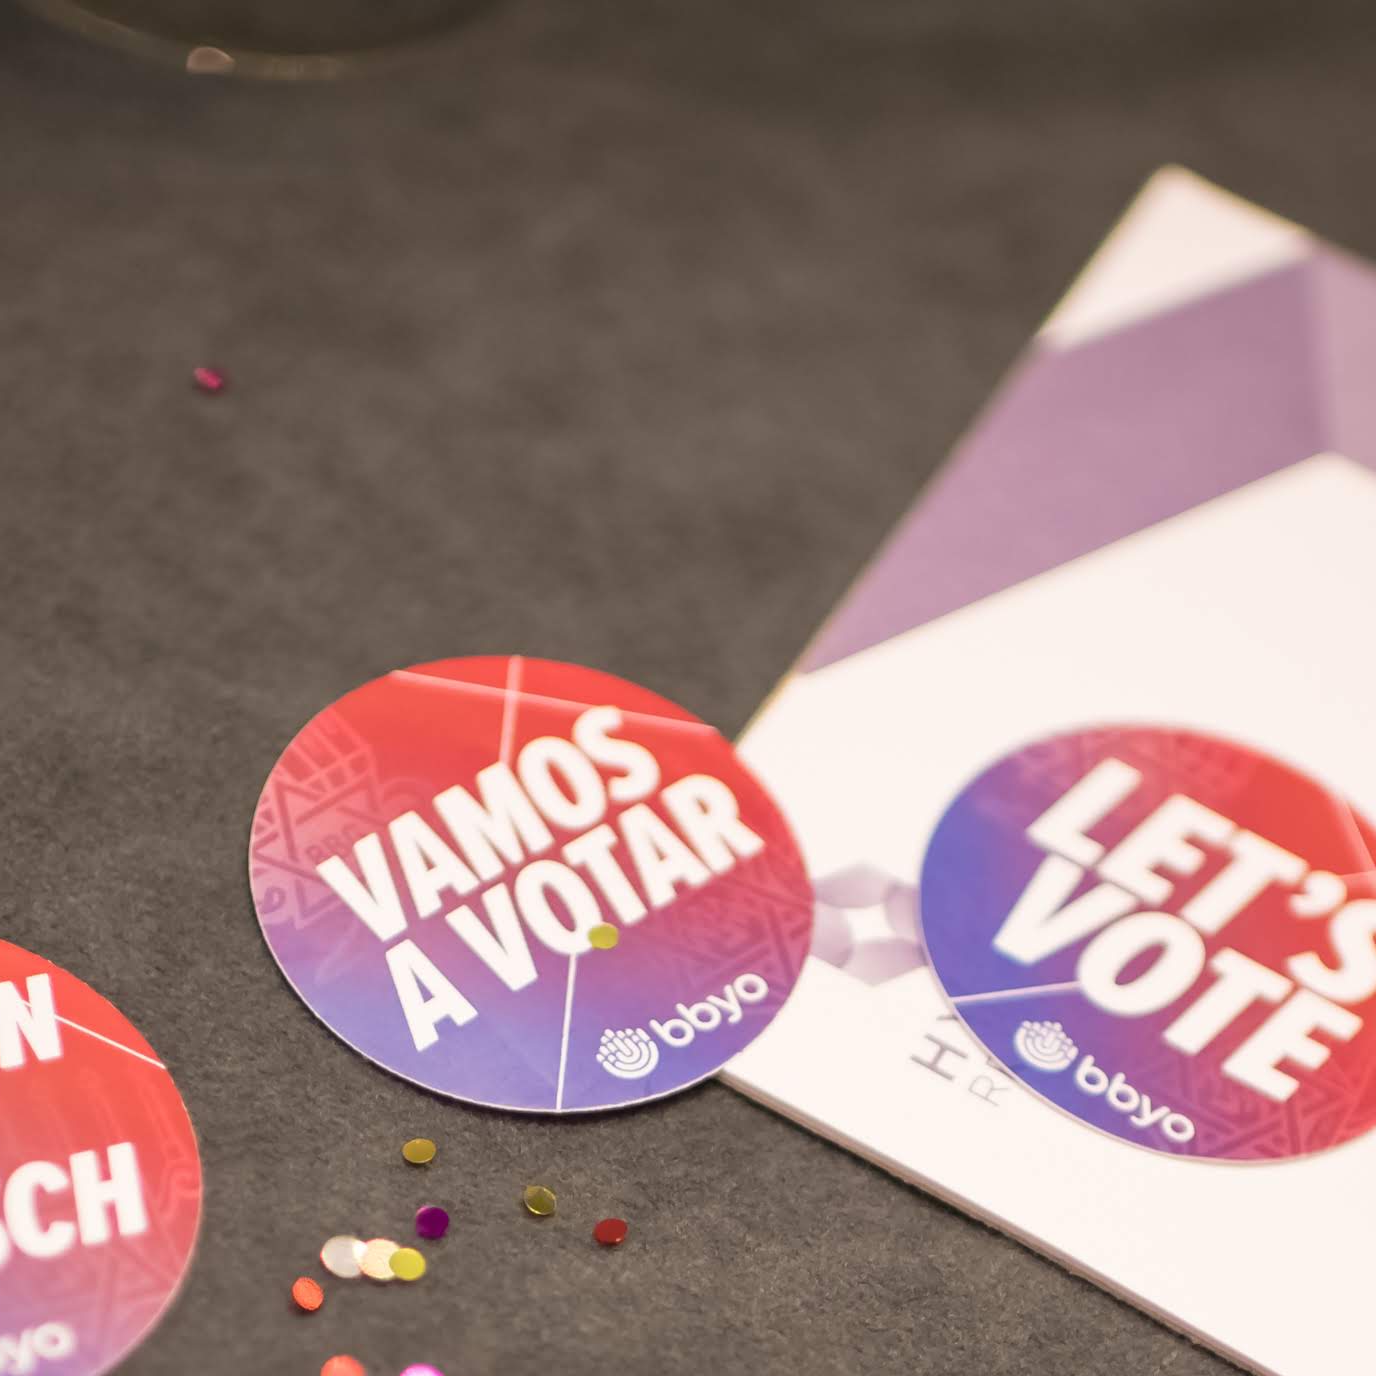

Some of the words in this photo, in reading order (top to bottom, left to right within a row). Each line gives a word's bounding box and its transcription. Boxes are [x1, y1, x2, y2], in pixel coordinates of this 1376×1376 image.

[315, 706, 660, 942] VAMOS
[385, 939, 479, 1054] A
[445, 774, 766, 992] VOTAR
[649, 972, 769, 1047] bbyo
[992, 851, 1364, 1104] VOTE
[1074, 1054, 1196, 1143] bbyo
